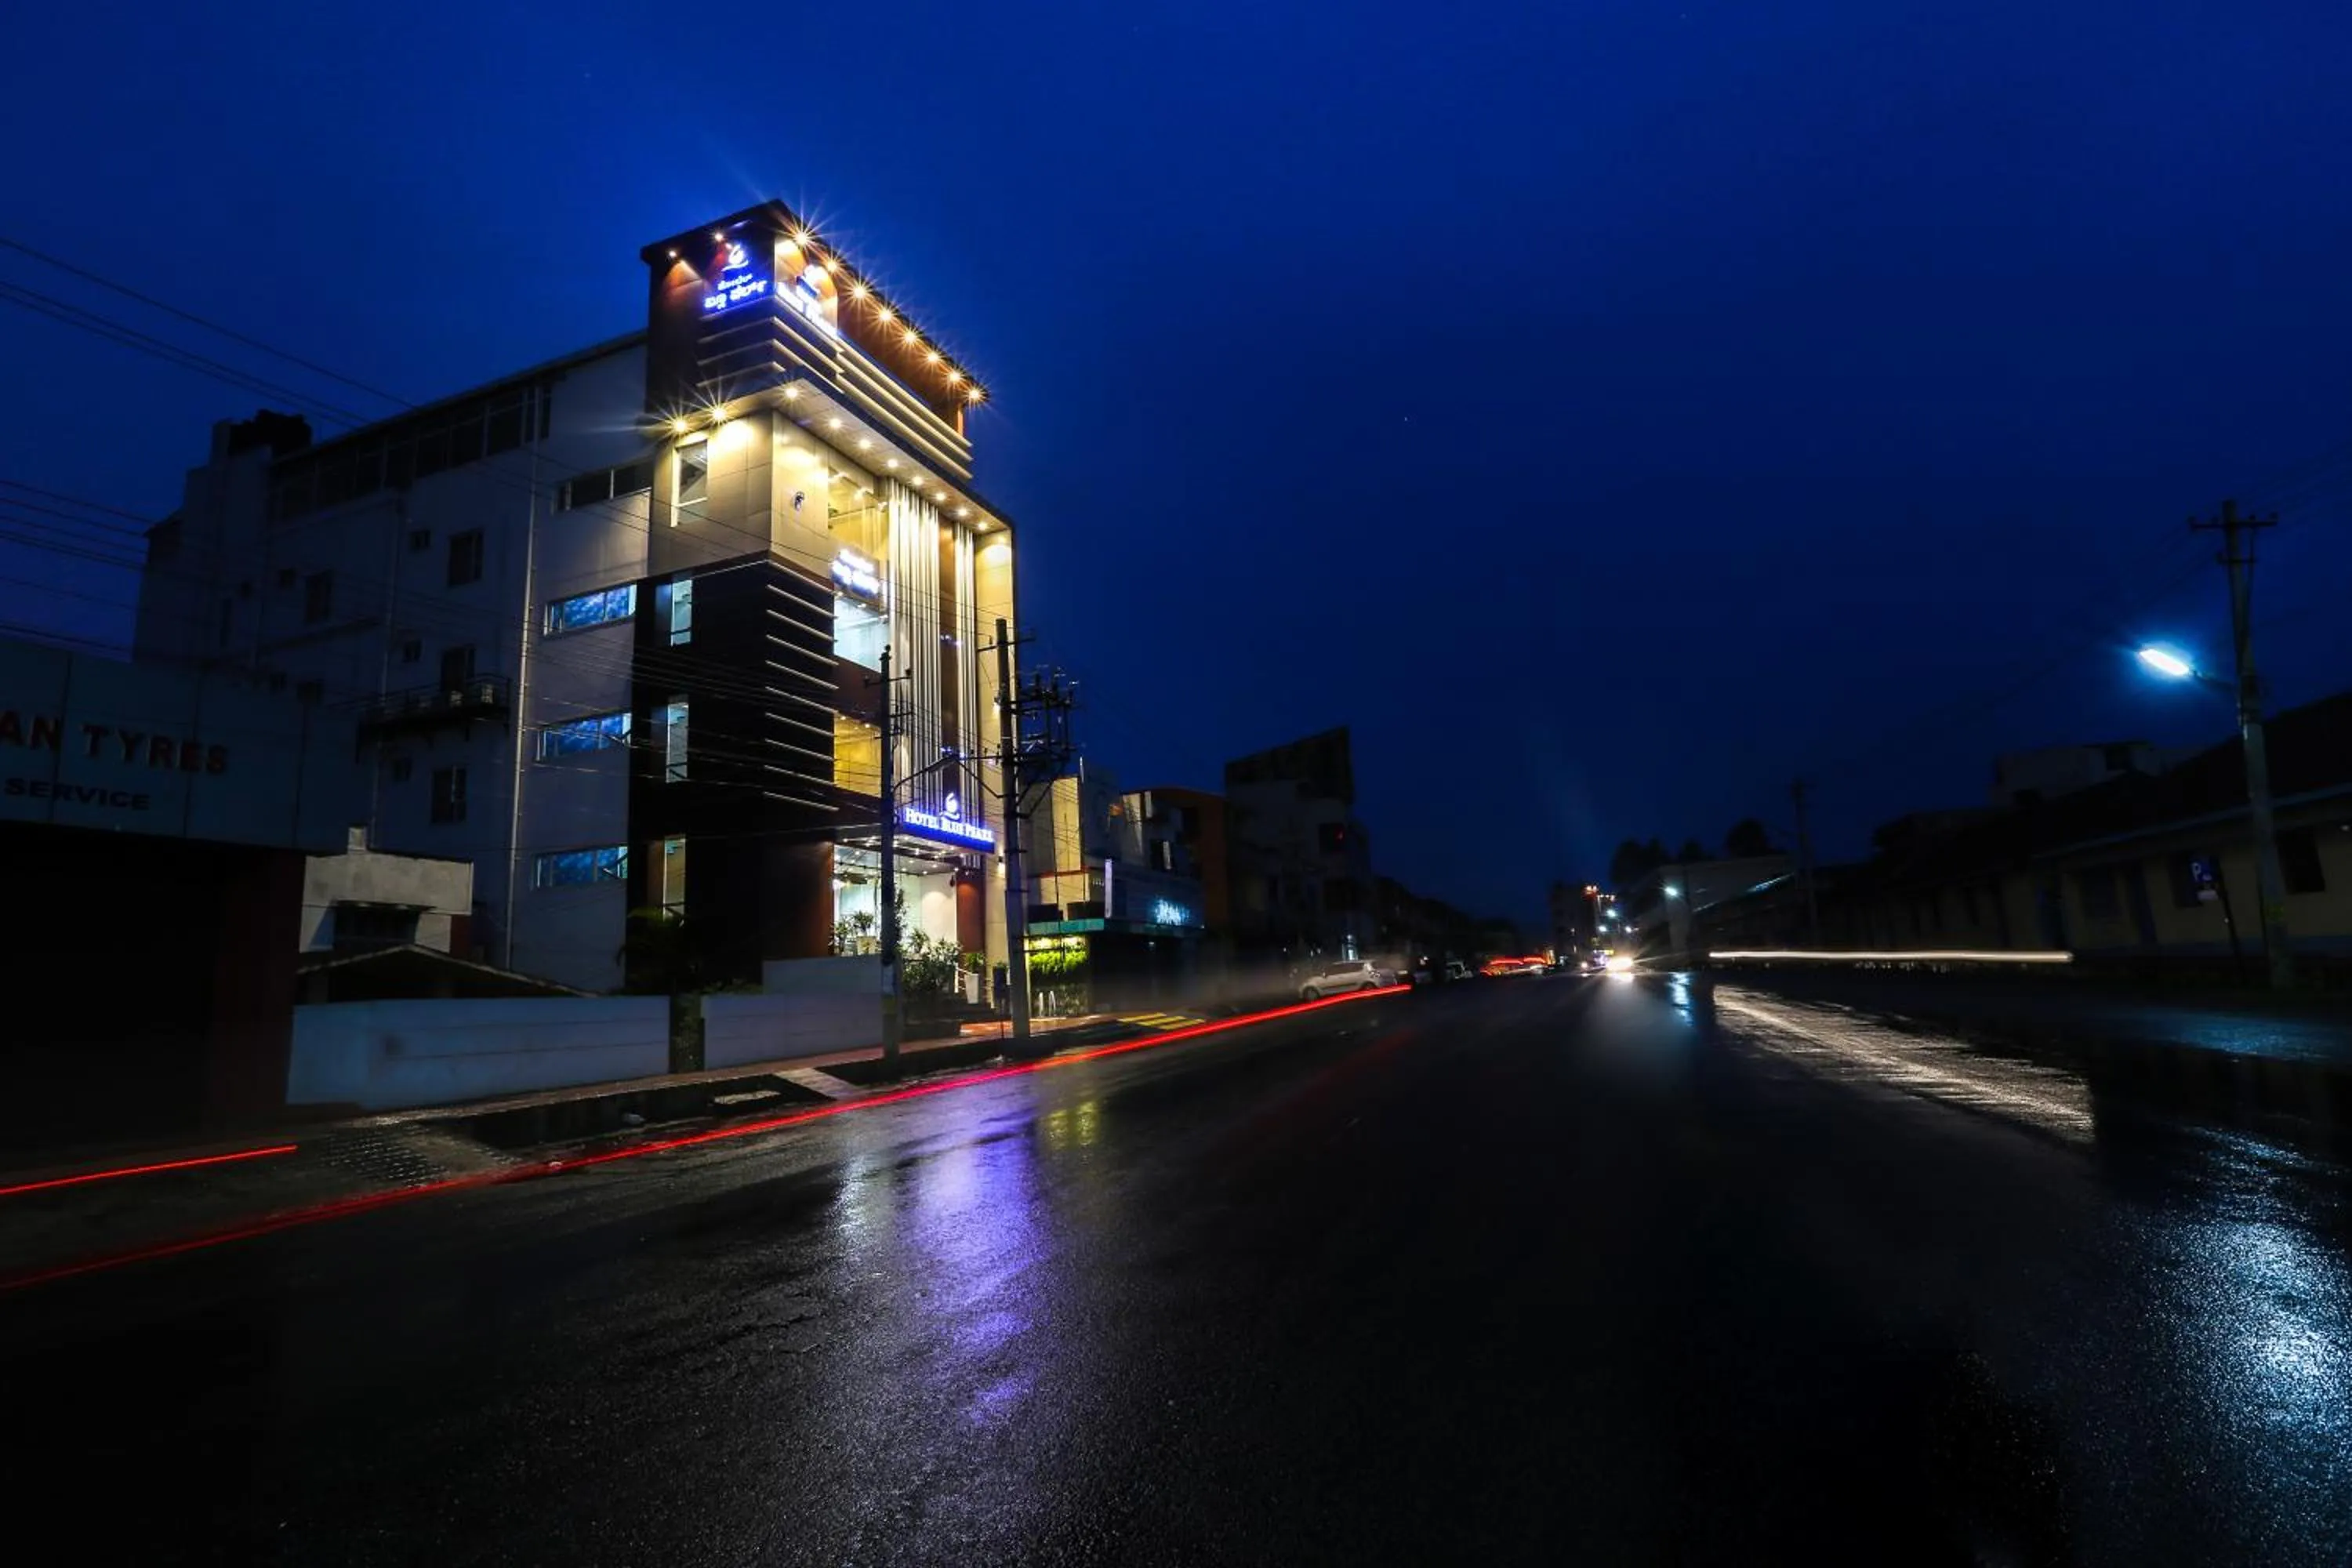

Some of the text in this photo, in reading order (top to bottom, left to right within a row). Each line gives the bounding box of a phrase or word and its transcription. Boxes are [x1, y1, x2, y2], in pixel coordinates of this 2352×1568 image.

[81, 721, 227, 774] TYRES
[4, 777, 151, 811] SERVICE
[906, 807, 940, 830] HOTEL
